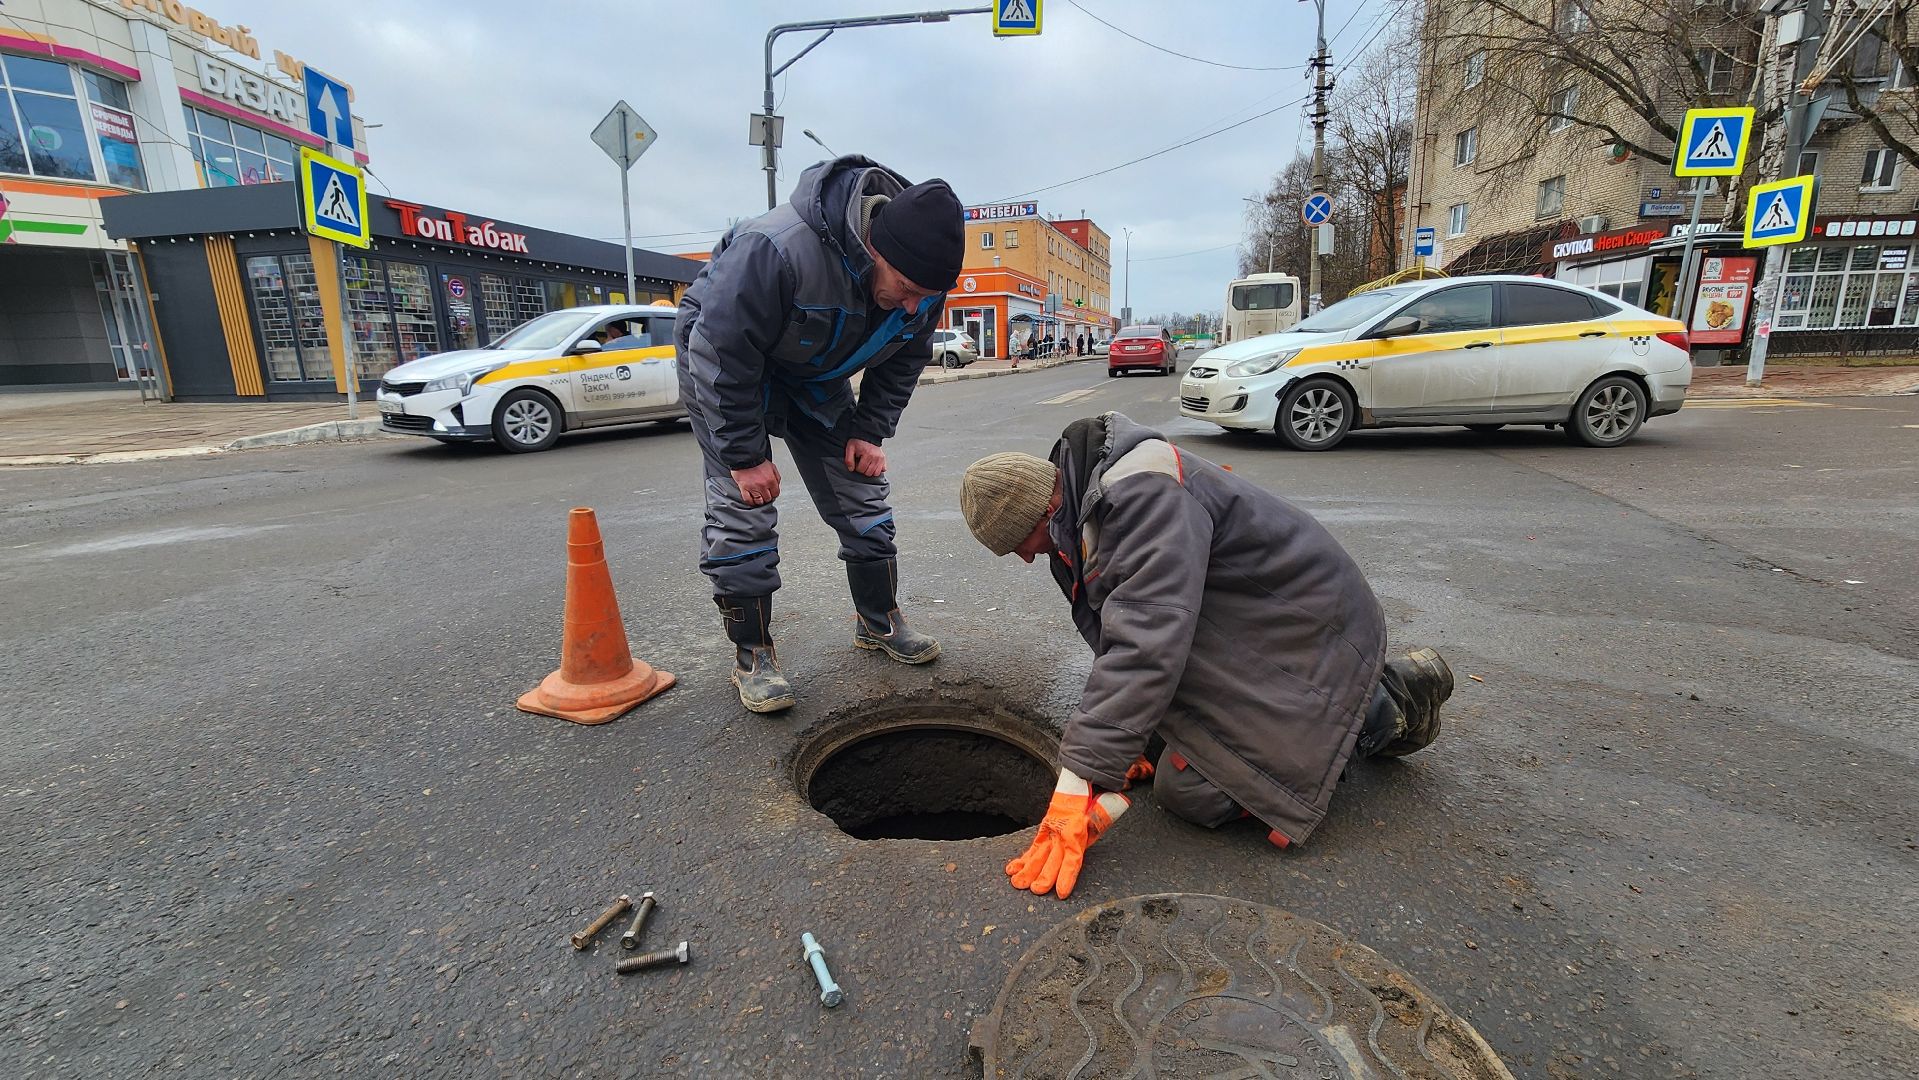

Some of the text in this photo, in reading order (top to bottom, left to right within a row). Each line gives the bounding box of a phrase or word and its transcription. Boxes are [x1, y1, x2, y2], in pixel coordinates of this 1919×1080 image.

[196, 54, 300, 124] БАЗАР
[1652, 190, 1660, 198] 21
[979, 204, 1027, 219] МЕБЕЛЬ
[1553, 238, 1594, 258] СКУПКА
[580, 367, 630, 383] Яндекс Go
[582, 382, 610, 393] Такси
